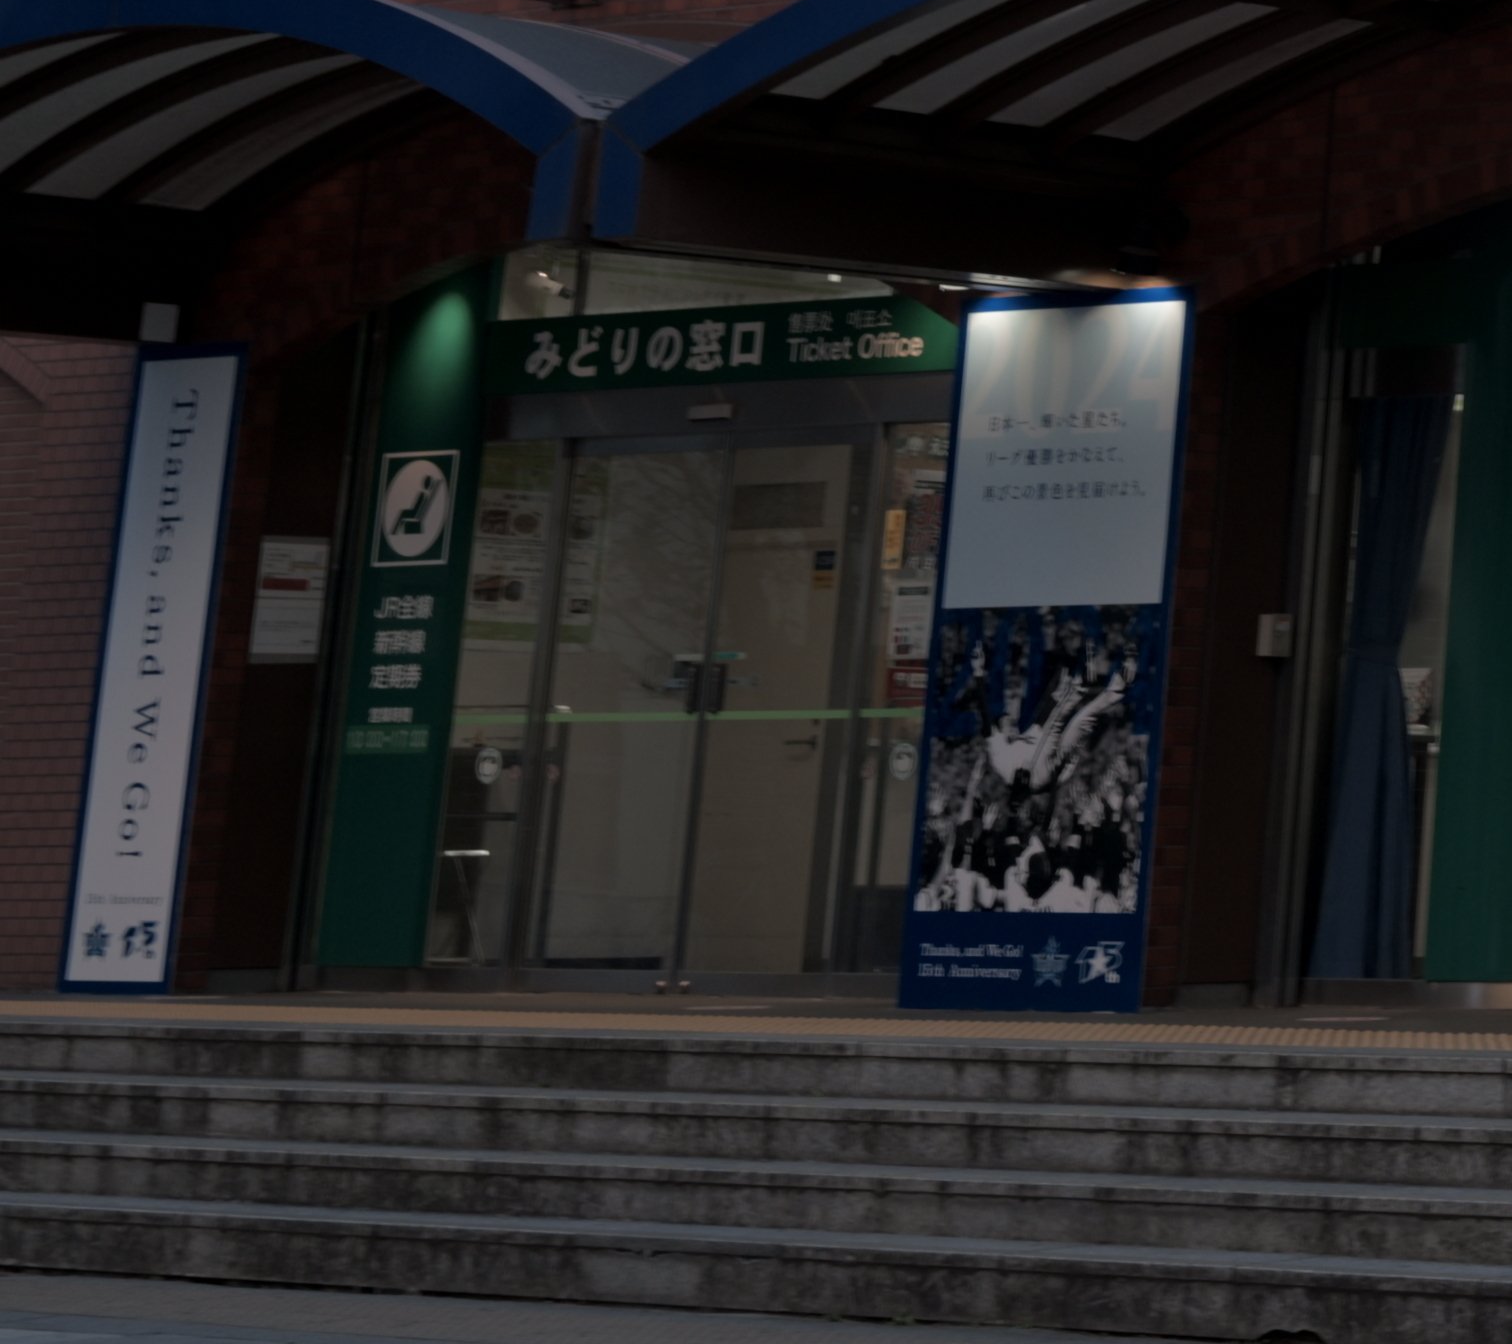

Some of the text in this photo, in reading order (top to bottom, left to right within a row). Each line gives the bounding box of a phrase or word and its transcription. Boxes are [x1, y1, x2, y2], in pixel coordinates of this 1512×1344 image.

[525, 317, 768, 381] みどりの窓口
[785, 330, 925, 364] Ticket Office
[147, 388, 200, 578] Thanks,
[137, 593, 169, 677] and
[125, 698, 162, 764] We
[115, 781, 150, 860] Go!
